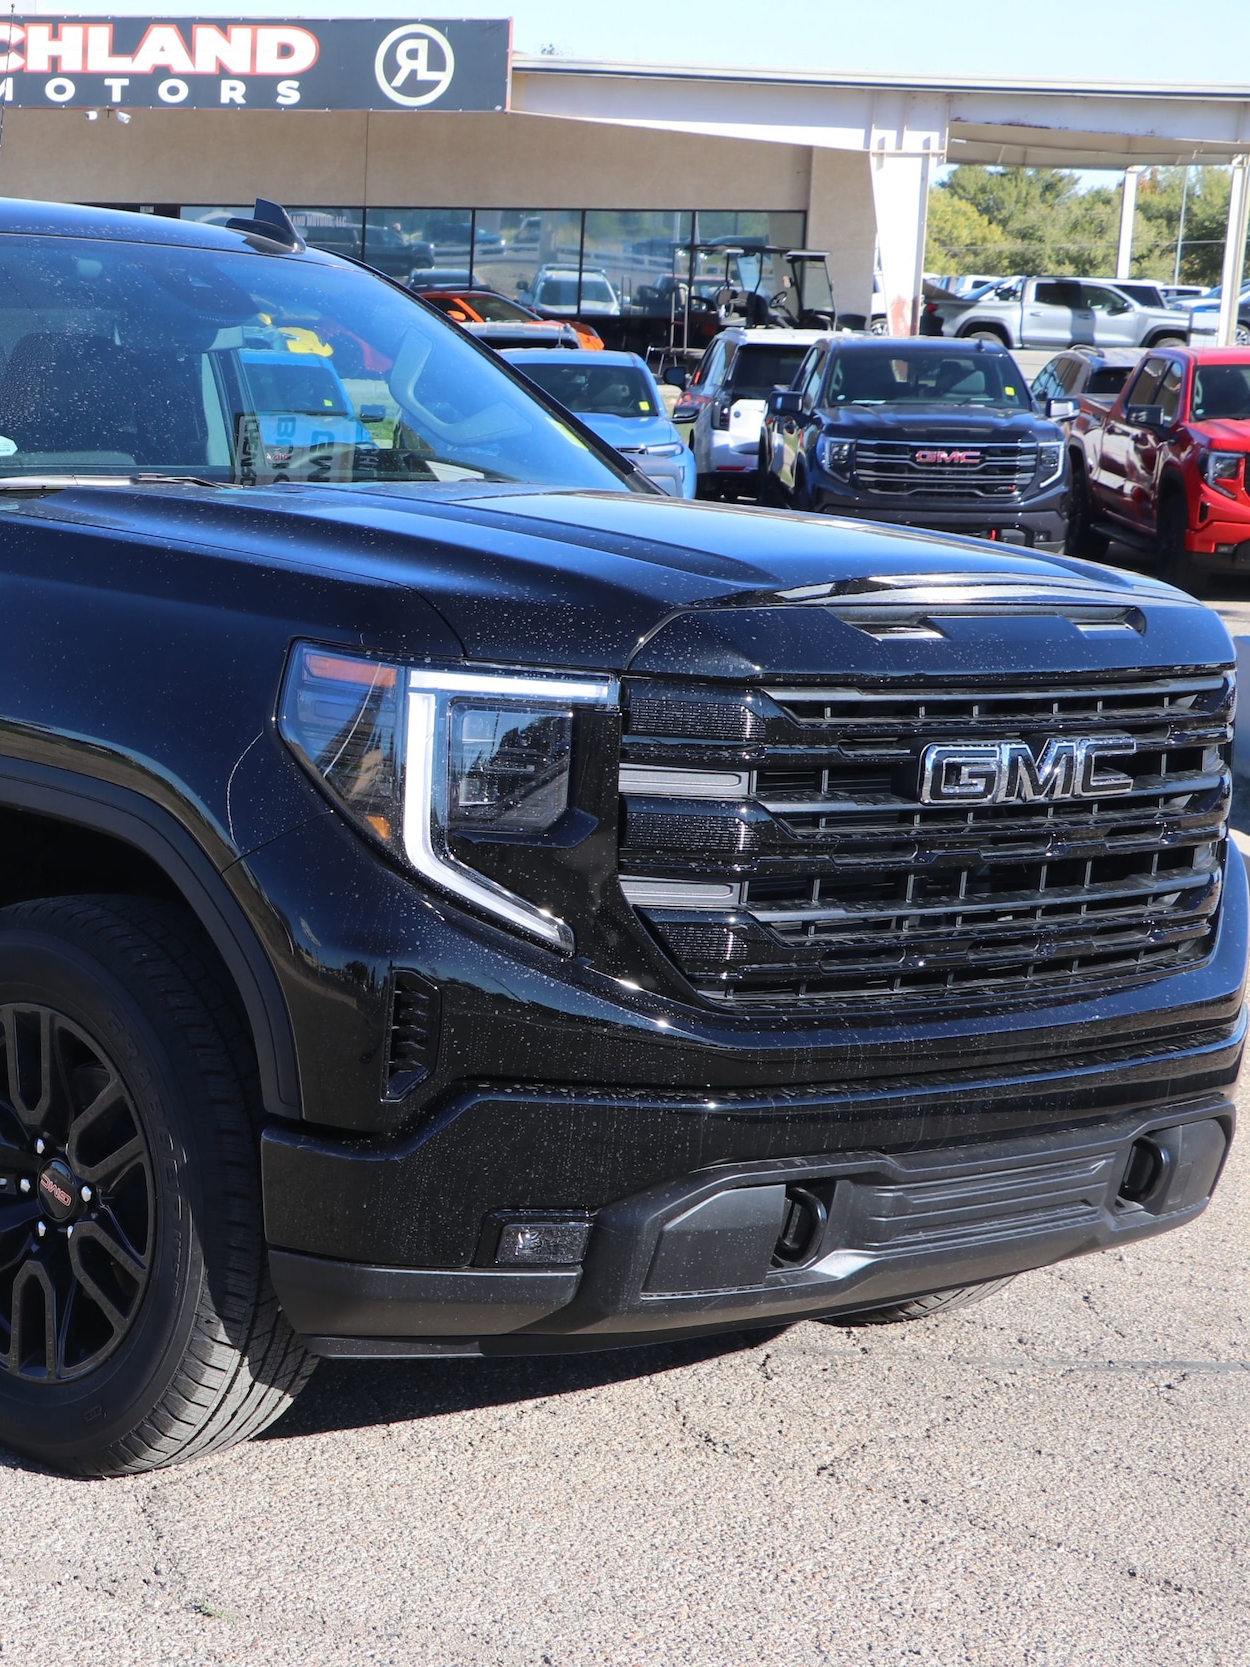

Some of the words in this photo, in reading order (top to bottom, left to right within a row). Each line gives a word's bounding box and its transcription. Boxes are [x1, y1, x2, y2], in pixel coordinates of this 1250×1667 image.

[915, 451, 981, 464] GMC
[918, 736, 1137, 806] GMC
[40, 1173, 72, 1206] GMC
